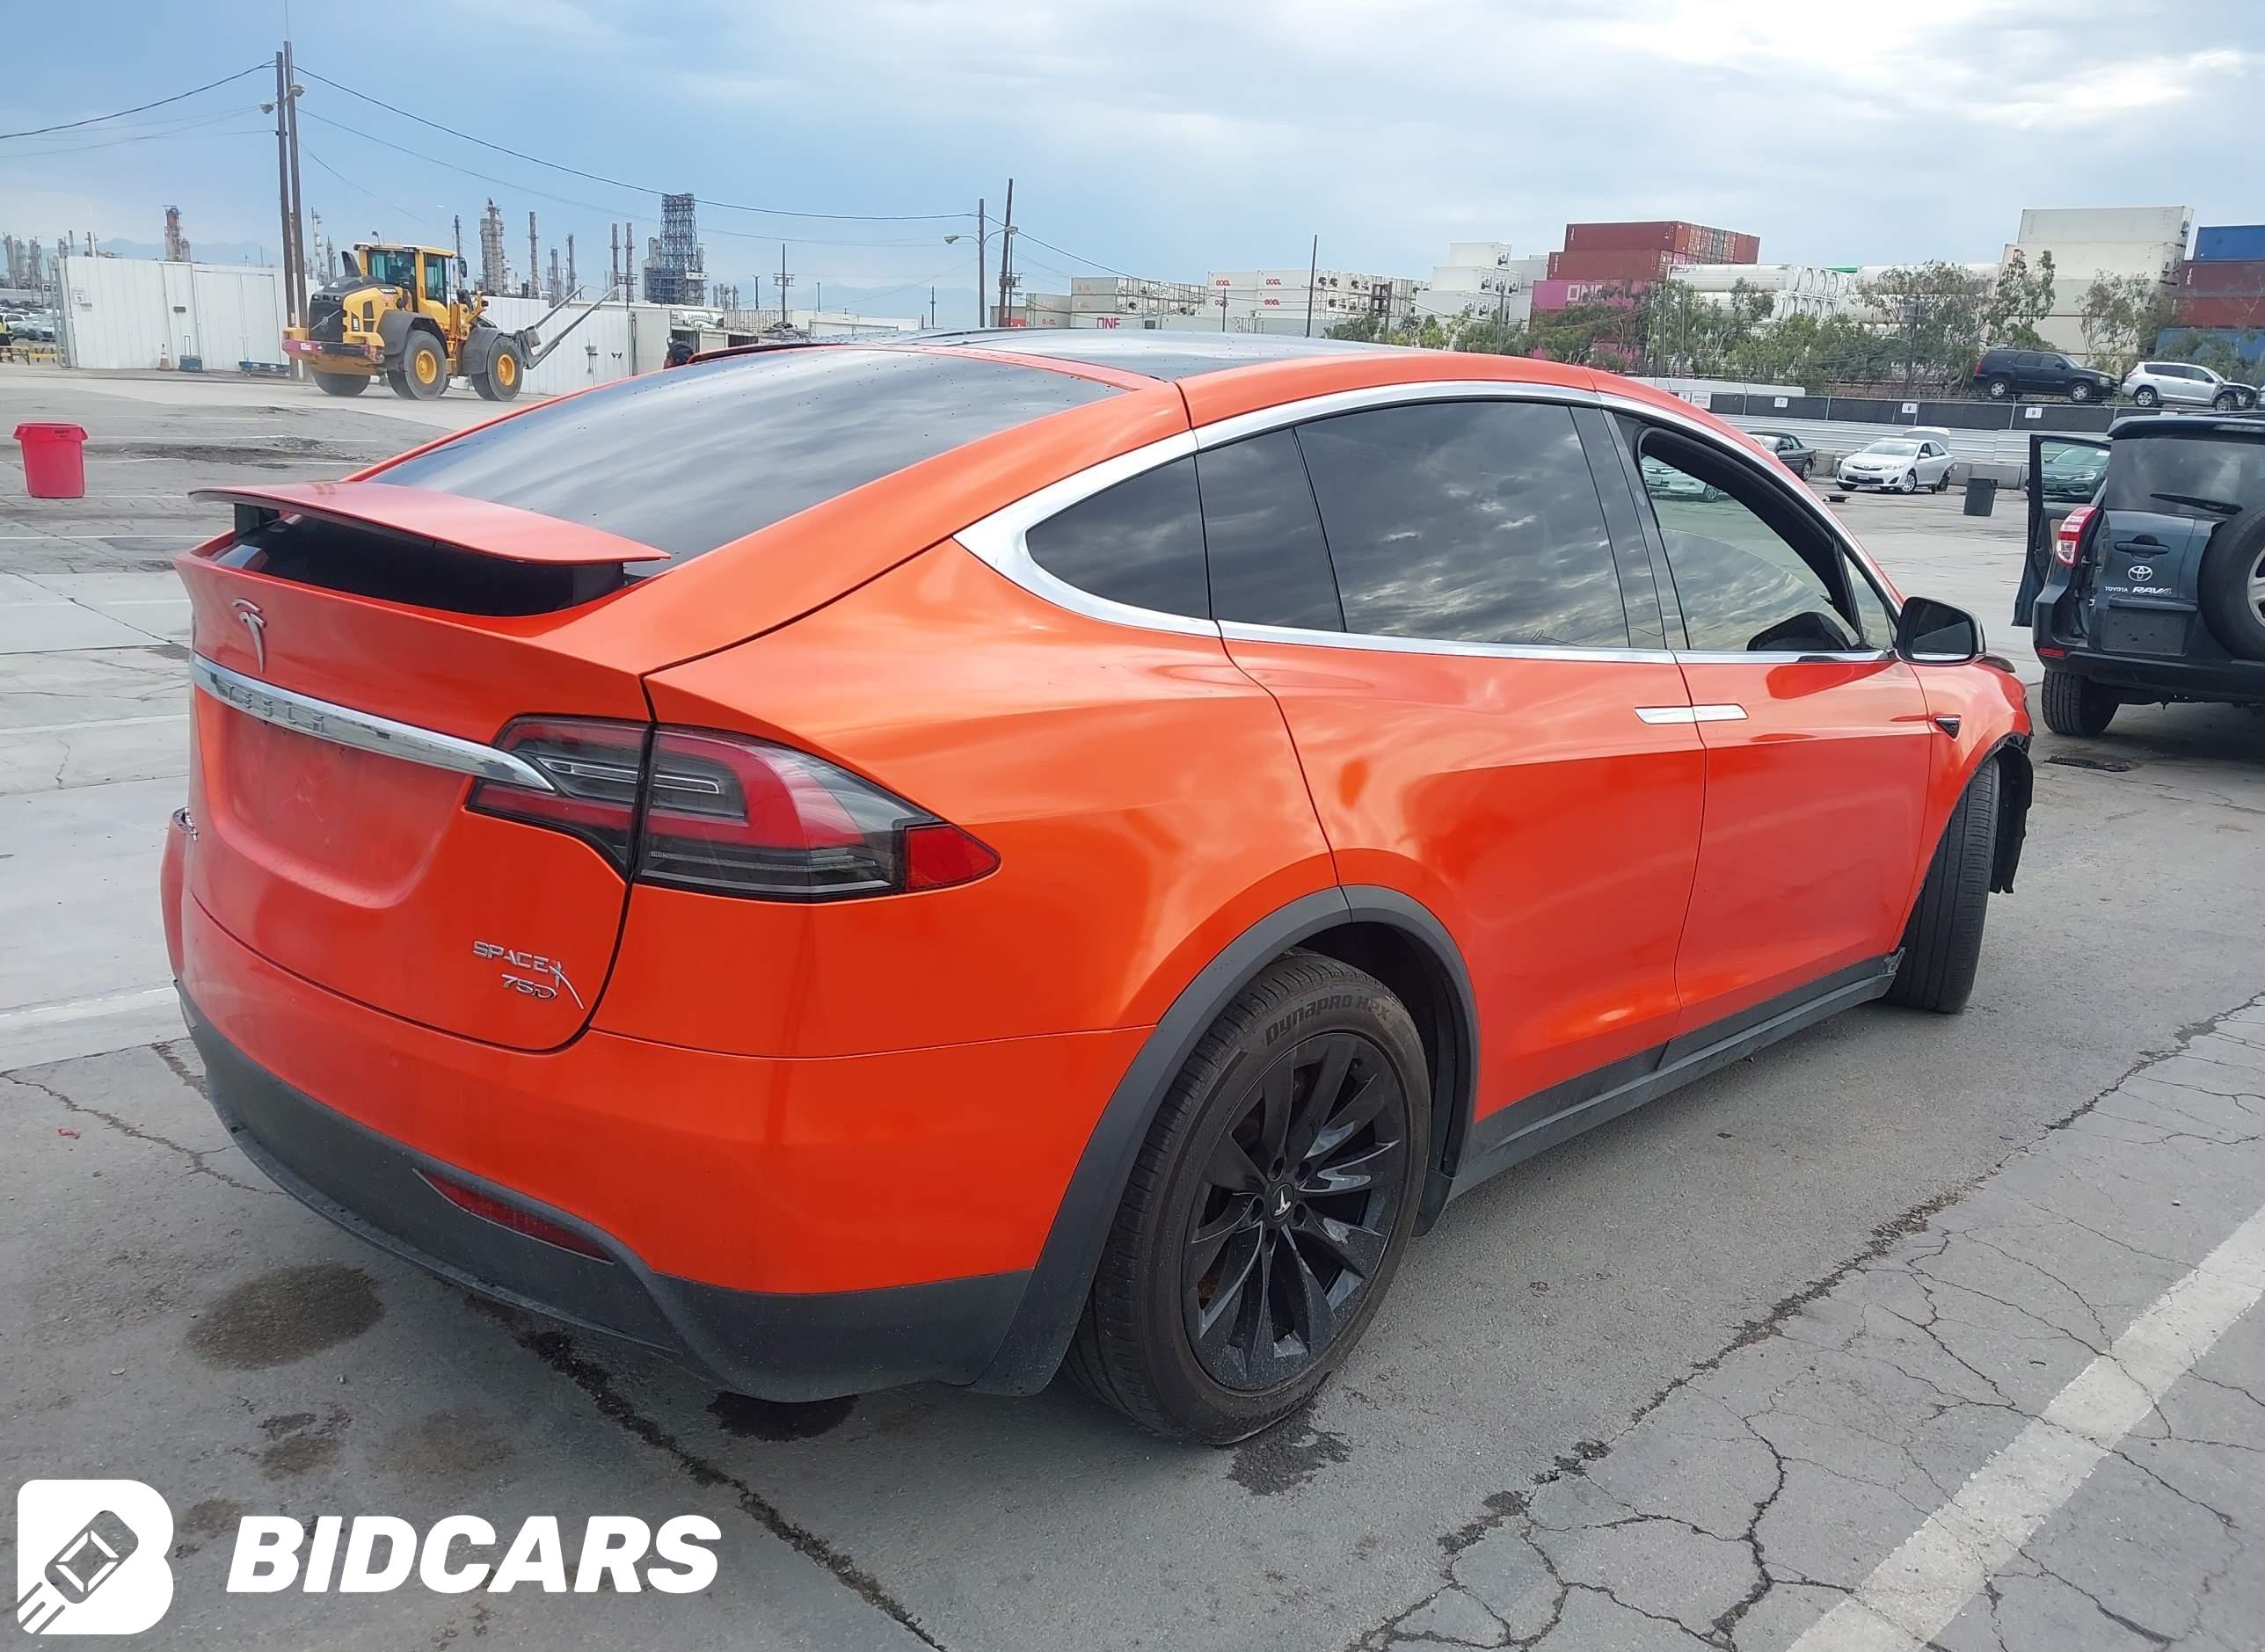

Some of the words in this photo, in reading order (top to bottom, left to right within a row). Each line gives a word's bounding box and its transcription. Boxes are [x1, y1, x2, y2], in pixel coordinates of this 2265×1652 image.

[2132, 586, 2172, 596] RAV4
[225, 681, 325, 733] TESLA
[501, 973, 558, 1000] 75D
